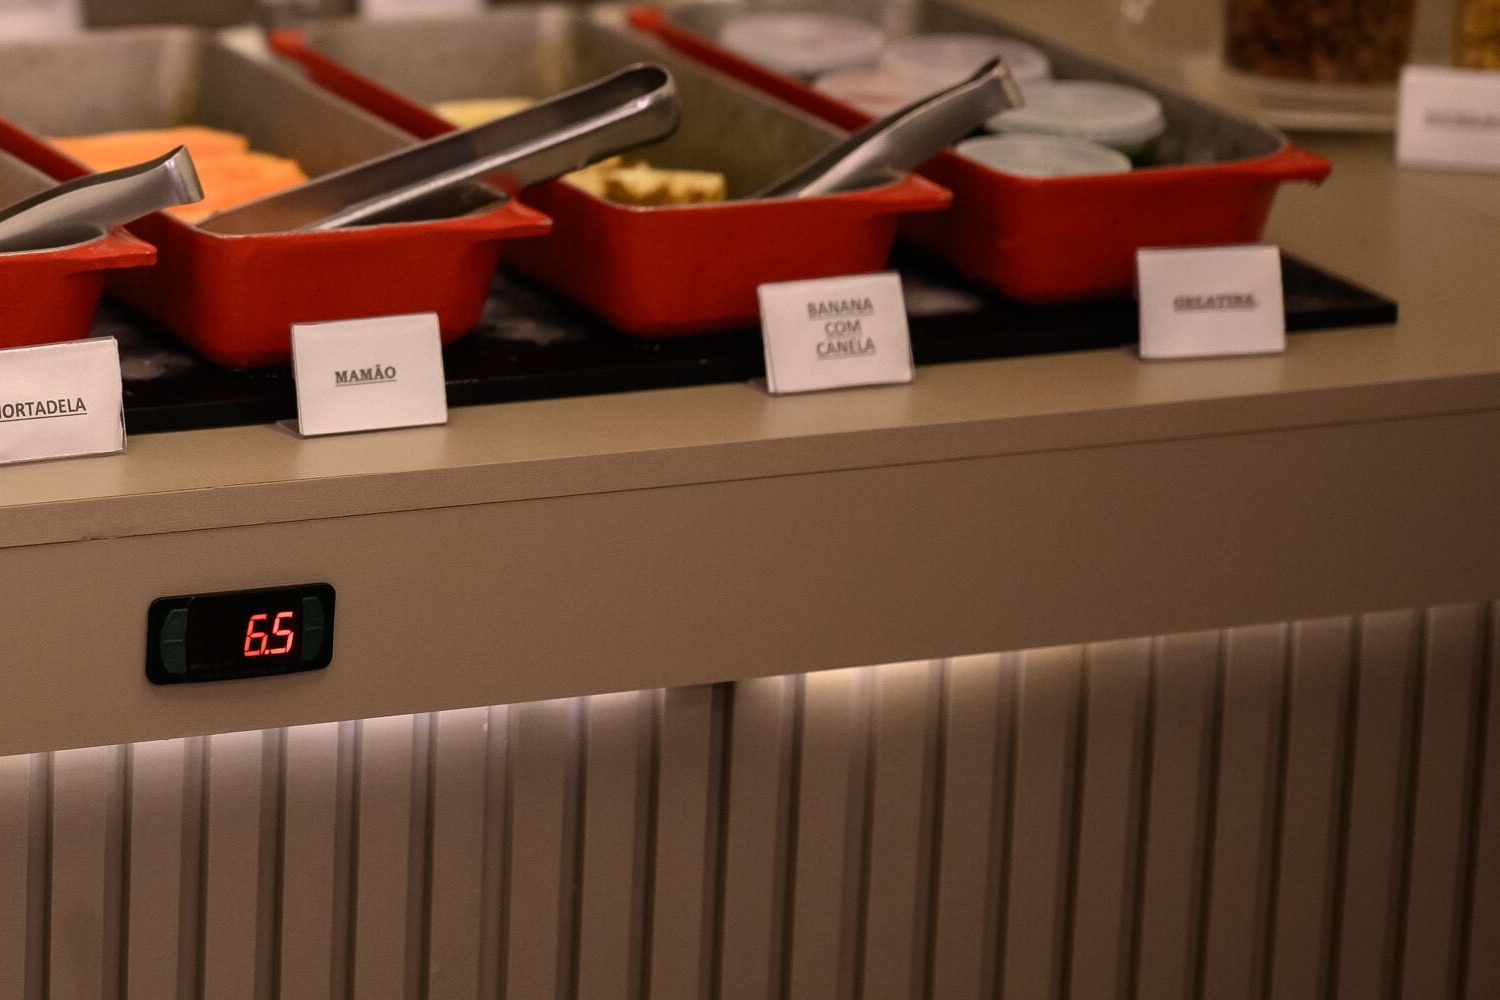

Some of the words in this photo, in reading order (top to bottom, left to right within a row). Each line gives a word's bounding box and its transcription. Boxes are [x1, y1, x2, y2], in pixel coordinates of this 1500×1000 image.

[807, 298, 874, 317] BANANA
[824, 320, 861, 337] COM
[816, 337, 876, 358] CANELA
[334, 364, 397, 386] MAMÃO
[244, 611, 294, 656] 6.5
